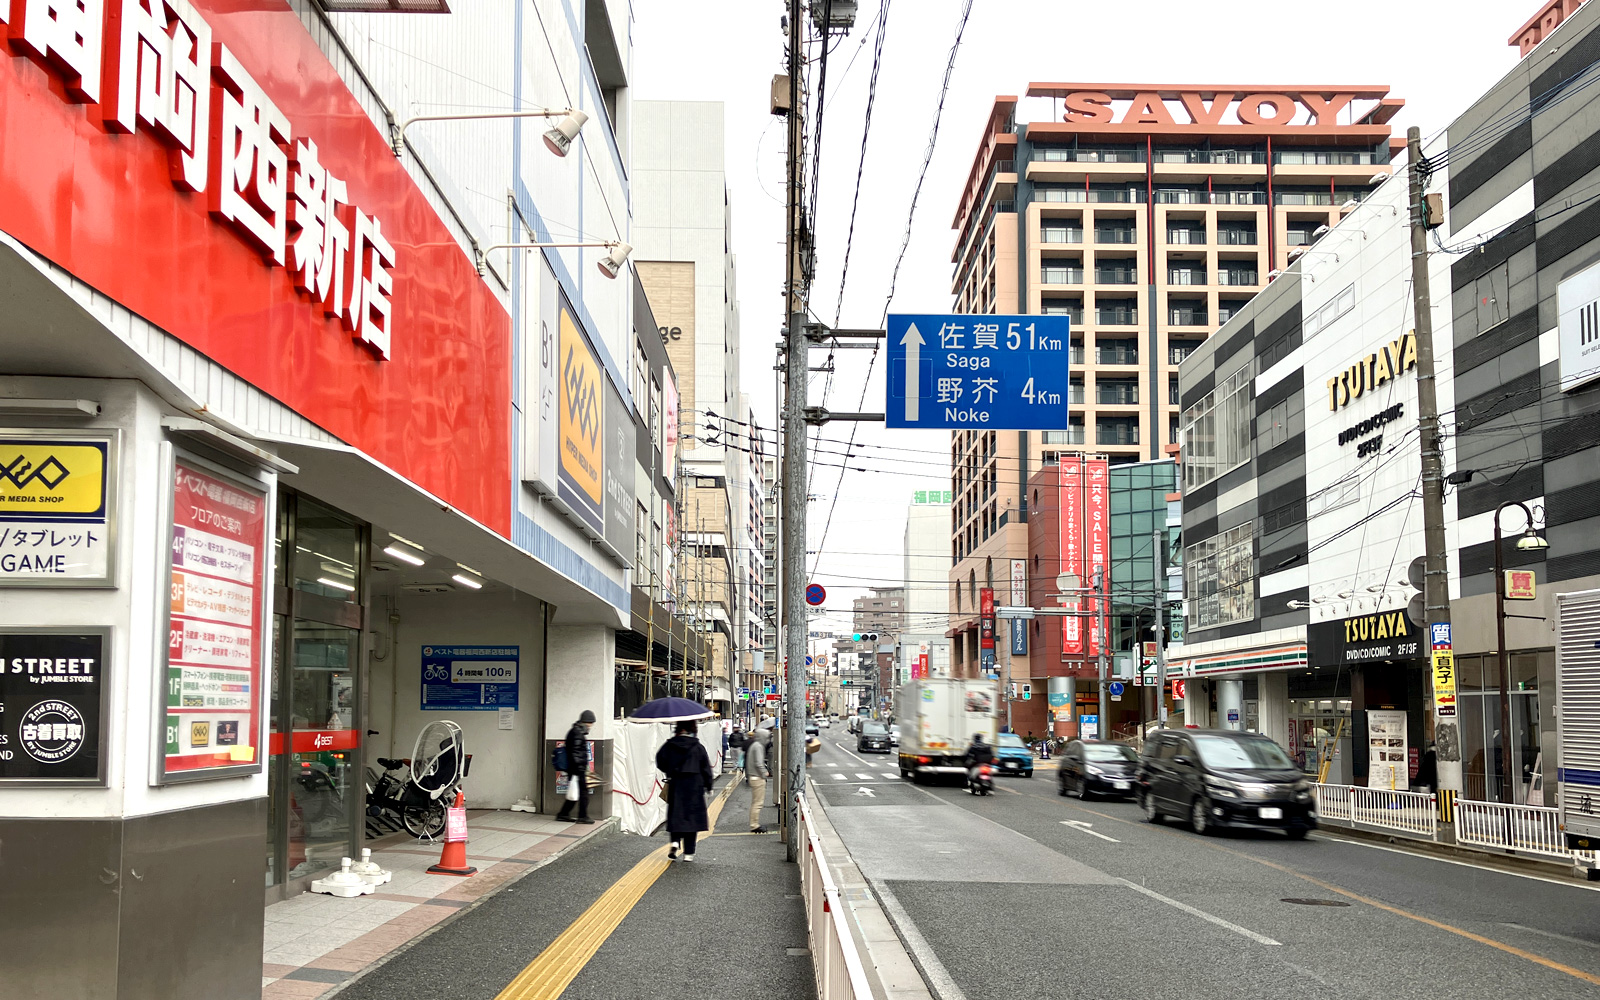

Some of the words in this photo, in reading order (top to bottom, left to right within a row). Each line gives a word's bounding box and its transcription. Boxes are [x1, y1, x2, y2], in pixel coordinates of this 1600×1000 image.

[1063, 91, 1356, 125] SAVOY
[938, 322, 999, 350] 佐賀
[946, 353, 990, 370] Saga
[1327, 328, 1417, 411] TSUTAYA
[937, 377, 998, 404] 野芥
[1021, 377, 1061, 404] 4Km
[945, 408, 989, 422] Noke
[607, 470, 618, 500] 2nd
[617, 483, 633, 519] STREET
[191, 505, 241, 535] フロアのご案内
[172, 537, 184, 554] 4F
[1, 554, 65, 573] GAME
[171, 583, 184, 600] 3F
[1344, 612, 1407, 643] TSUTAYA
[1433, 624, 1451, 643] 質
[170, 630, 183, 648] 2F
[1346, 646, 1391, 660] DVD/CD/COMIC
[1398, 643, 1417, 655] 2F/3F
[11, 658, 94, 674] STREET
[818, 657, 826, 665] 40
[1436, 656, 1452, 684] 真子
[41, 676, 68, 684] JUMBLE
[169, 678, 181, 695] 1F
[28, 705, 46, 721] 2nd
[46, 703, 79, 720] STREET
[23, 724, 82, 740] 古着買取
[167, 726, 179, 743] B1
[321, 736, 333, 745] BEST
[27, 741, 37, 750] BY
[34, 747, 59, 759] JUMBLE
[59, 741, 77, 757] STORE
